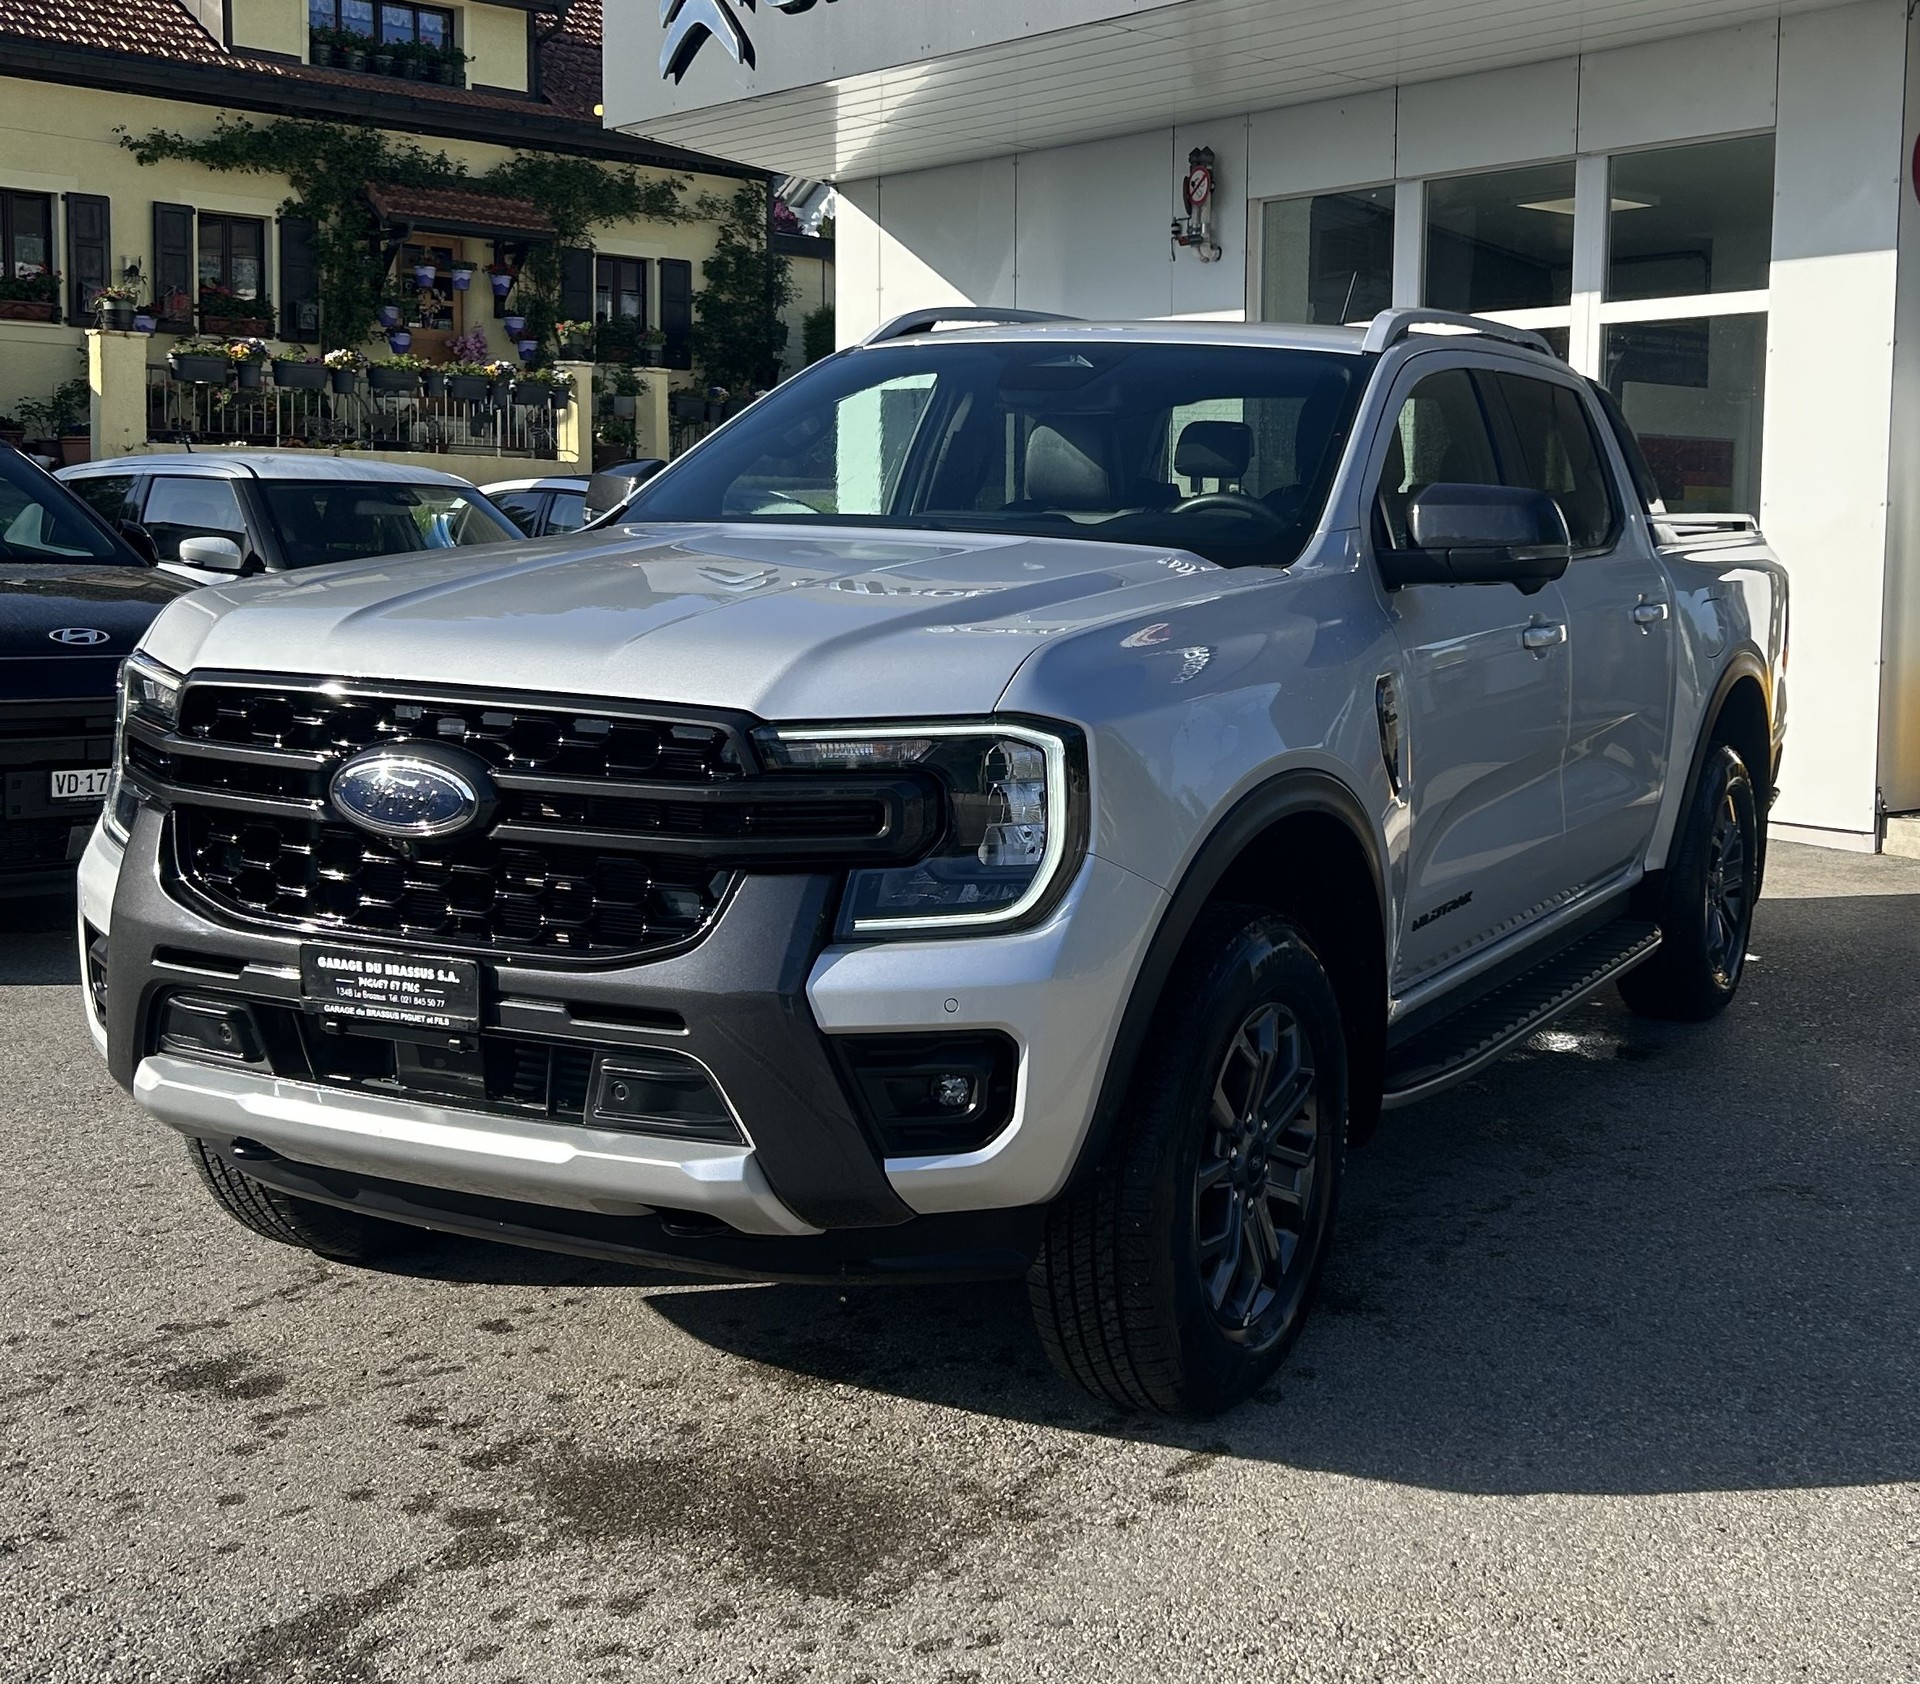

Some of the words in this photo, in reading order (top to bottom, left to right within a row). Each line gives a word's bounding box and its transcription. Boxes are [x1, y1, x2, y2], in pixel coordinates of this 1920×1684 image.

[55, 774, 78, 794] VD
[317, 956, 363, 973] GARAGE
[365, 961, 382, 974] DU
[384, 963, 435, 980] BRASSUS
[437, 969, 460, 984] S.A.
[358, 976, 389, 990] PIGUET
[389, 980, 401, 991] ET
[401, 981, 421, 994] FILS
[336, 987, 353, 997] 1348
[354, 989, 362, 998] Le
[400, 994, 412, 1004] 021
[413, 997, 427, 1006] 845
[427, 998, 436, 1007] 50
[436, 999, 446, 1008] 77
[323, 1004, 356, 1015] GARAGE
[355, 1008, 366, 1016] du
[366, 1008, 400, 1020] BRASSUS
[400, 1012, 426, 1023] PIGUET
[426, 1016, 434, 1025] et
[434, 1016, 450, 1026] FILS
